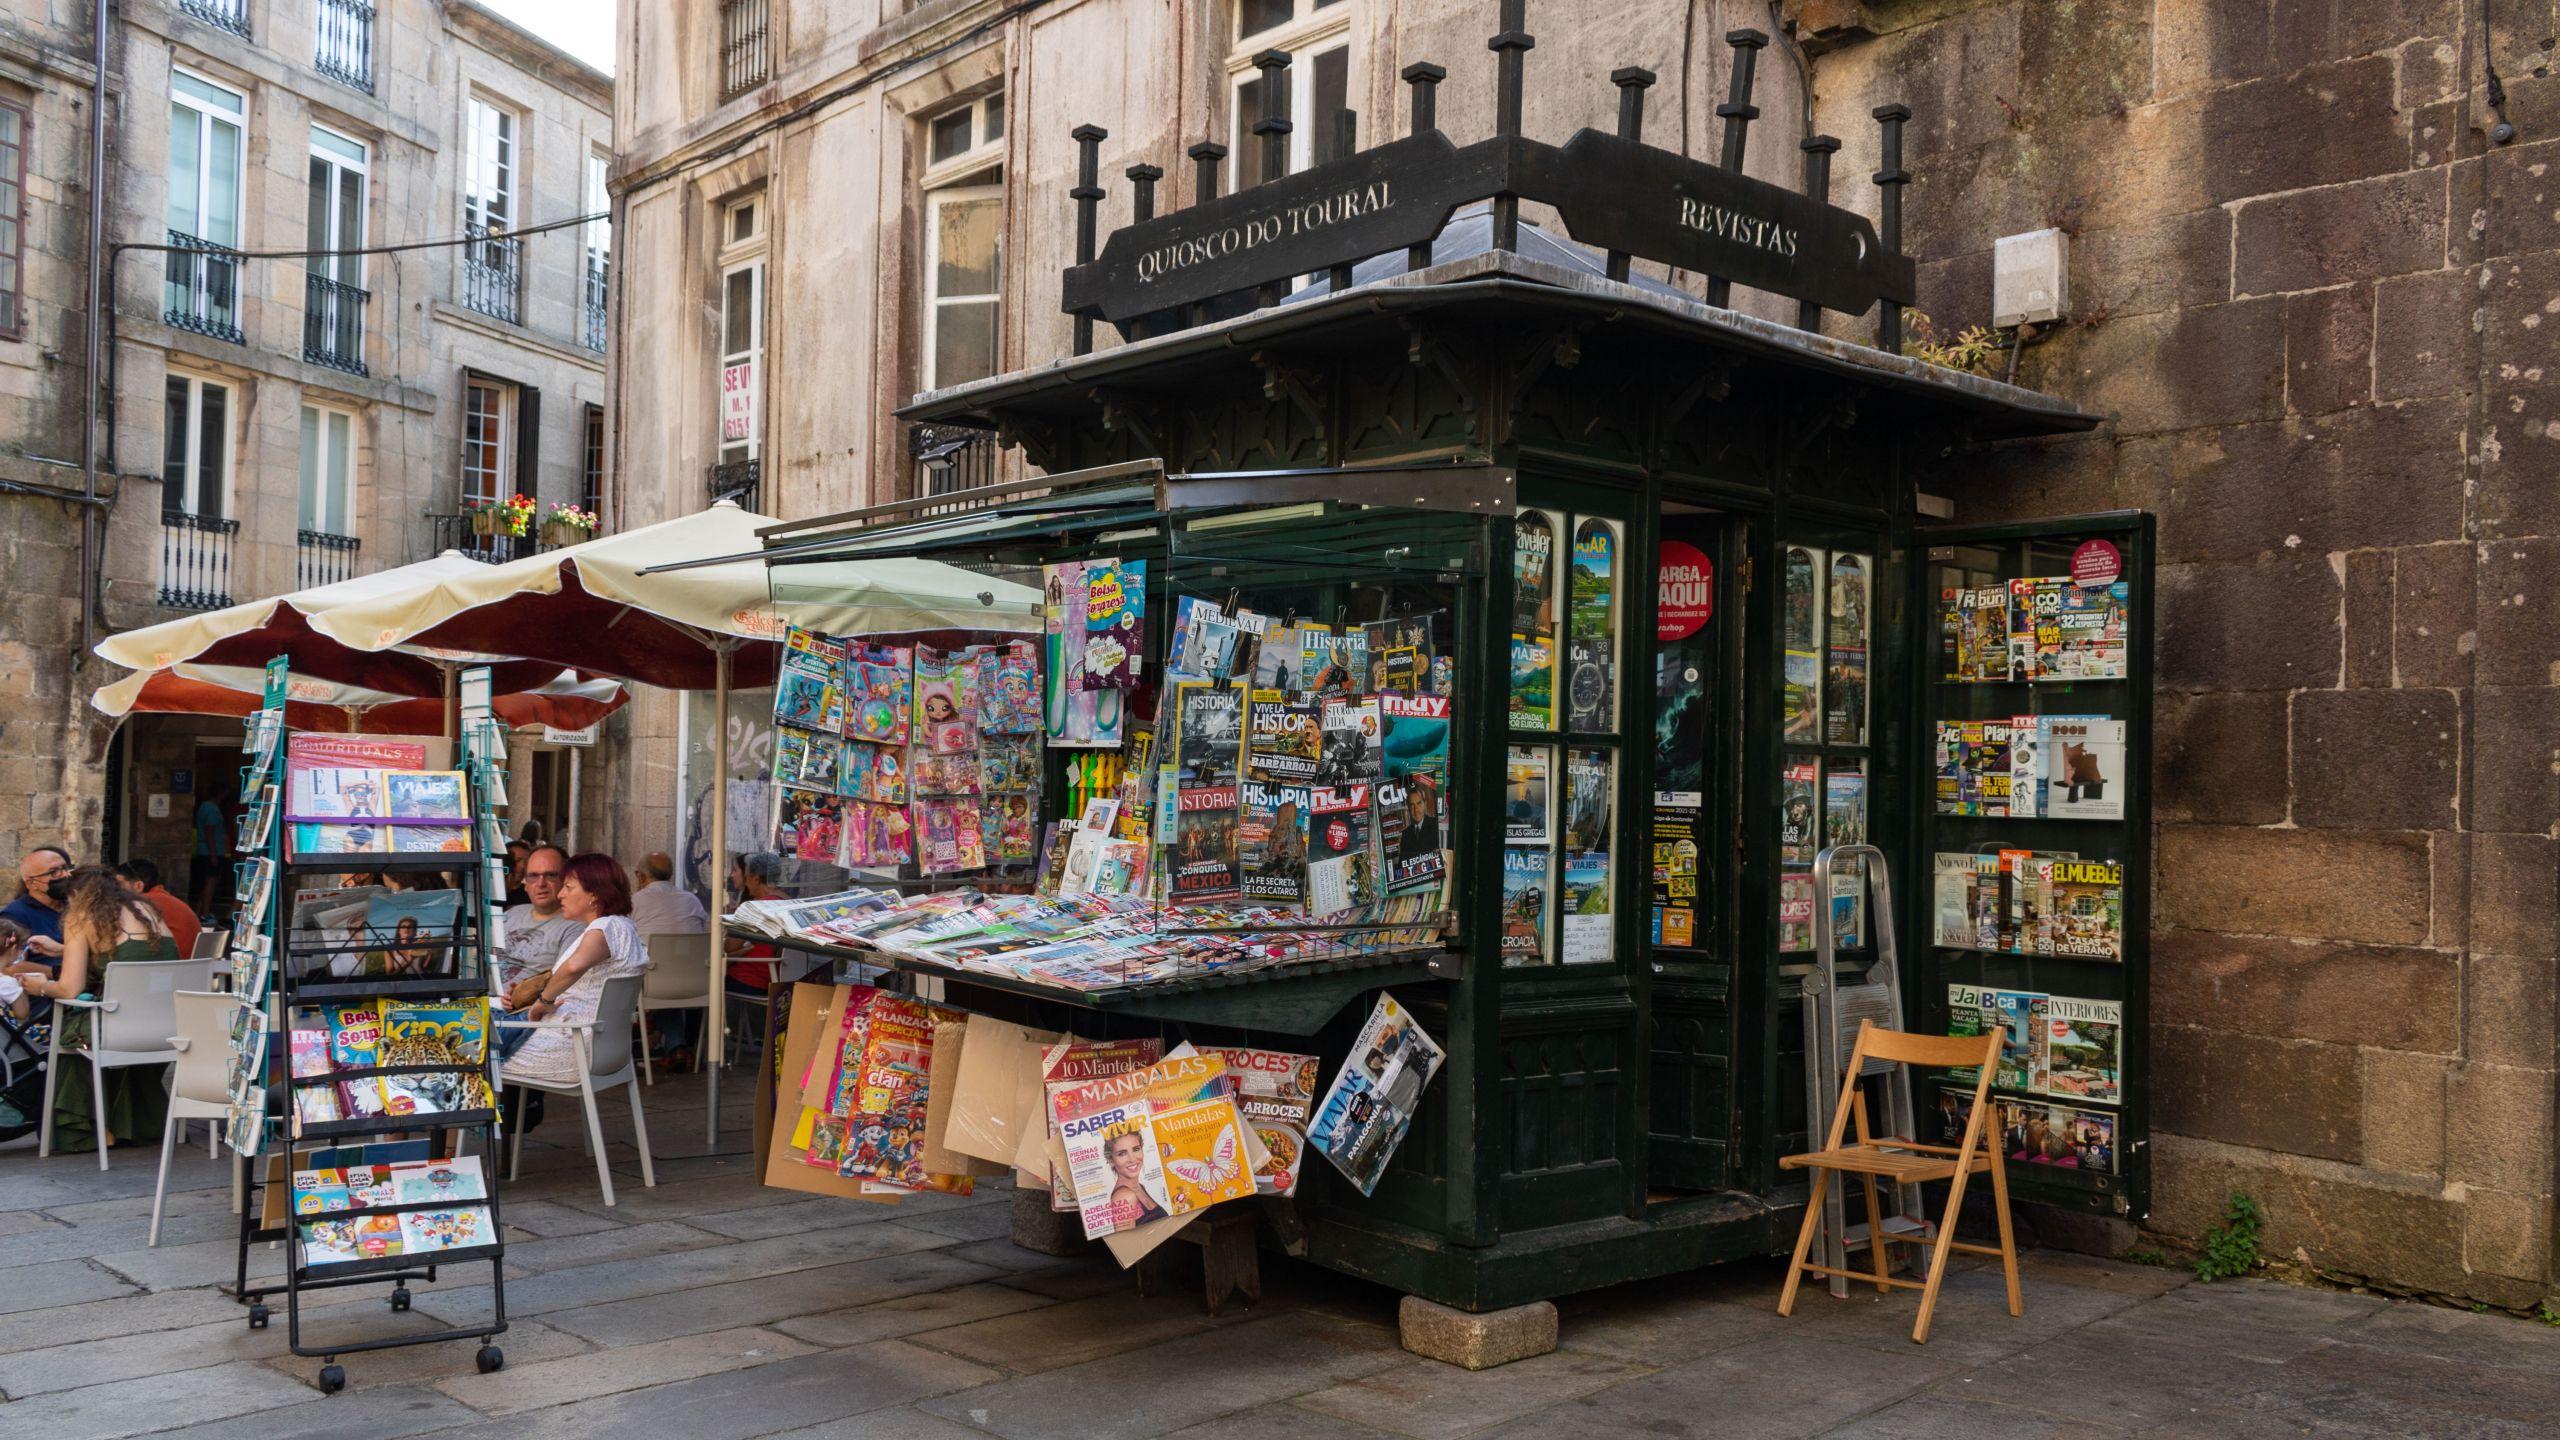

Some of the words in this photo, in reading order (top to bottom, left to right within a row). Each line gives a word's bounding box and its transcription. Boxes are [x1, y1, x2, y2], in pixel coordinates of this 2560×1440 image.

[1138, 227, 1240, 283] QUIOSCO
[1246, 215, 1282, 249] DO
[1287, 180, 1396, 235] TOURAL
[1680, 197, 1797, 257] REVISTAS
[725, 368, 738, 392] SE
[732, 397, 743, 412] M.
[726, 418, 744, 438] 615
[1658, 565, 1700, 583] ARGA
[1090, 583, 1117, 598] Bolsa
[1658, 575, 1711, 609] AQUÍ
[1982, 587, 2004, 595] OTAKU
[1195, 607, 1262, 634] MEDIEVAL
[2061, 614, 2075, 629] 32
[2075, 613, 2102, 621] PREGUNTAS
[1511, 646, 1546, 662] VIAJES
[1598, 641, 1608, 652] 93
[1388, 655, 1413, 666] HISTORIA
[1188, 695, 1236, 710] HISTORIA
[1255, 703, 1275, 714] VIVE
[1275, 703, 1285, 714] LA
[1383, 696, 1447, 717] muy
[1253, 713, 1316, 731] HISTOR
[1521, 720, 1545, 729] EUROPA
[551, 734, 589, 743] AUTORIZADOS
[2052, 725, 2087, 736] ROOM
[1251, 756, 1317, 773] BARBARROJA
[398, 781, 451, 795] VIAJES
[1983, 776, 1992, 786] EL
[1241, 784, 1310, 809] HISTORIA
[1983, 786, 1999, 797] QUE
[1506, 828, 1522, 837] ISLAS
[1523, 828, 1545, 837] GRIEGAS
[1181, 864, 1228, 875] CONQUISTA
[1401, 860, 1409, 868] EL
[1504, 853, 1545, 871] VIAJES
[1571, 860, 1598, 870] VIAJES
[1245, 876, 1255, 884] LA
[1256, 877, 1265, 885] FE
[1265, 877, 1296, 887] SECRETA
[2053, 864, 2067, 882] EL
[2068, 864, 2120, 884] MUEBLE
[1241, 885, 1251, 893] DE
[1252, 885, 1267, 894] LOS
[1833, 885, 1858, 896] Santiago
[1501, 936, 1536, 947] CROACIA
[2056, 943, 2070, 952] DE
[2071, 944, 2113, 956] VERANO
[2067, 936, 2101, 947] CASAS
[2050, 1001, 2119, 1020] INTERIORES
[1355, 1002, 1386, 1052] MASCARILLA
[1062, 1060, 1078, 1077] 10
[1083, 1056, 1147, 1076] Manteles
[868, 1069, 903, 1089] clan
[1081, 1057, 1207, 1103] MANDALAS
[1243, 1101, 1304, 1119] ARROCES
[1313, 1069, 1363, 1143] VIAJAR
[1064, 1108, 1125, 1138] SABER
[1099, 1115, 1147, 1140] VIVIR
[1160, 1108, 1226, 1131] Mandalas
[1347, 1104, 1383, 1160] PATAGONIA
[1069, 1146, 1099, 1158] PIERNAS
[1070, 1152, 1100, 1164] LIGERAS
[359, 1188, 395, 1197] ANIMALS
[1084, 1199, 1129, 1216] ADELGAZA
[1085, 1205, 1130, 1223] COMIENDO
[1087, 1220, 1106, 1230] QUE
[1107, 1217, 1116, 1226] TE
